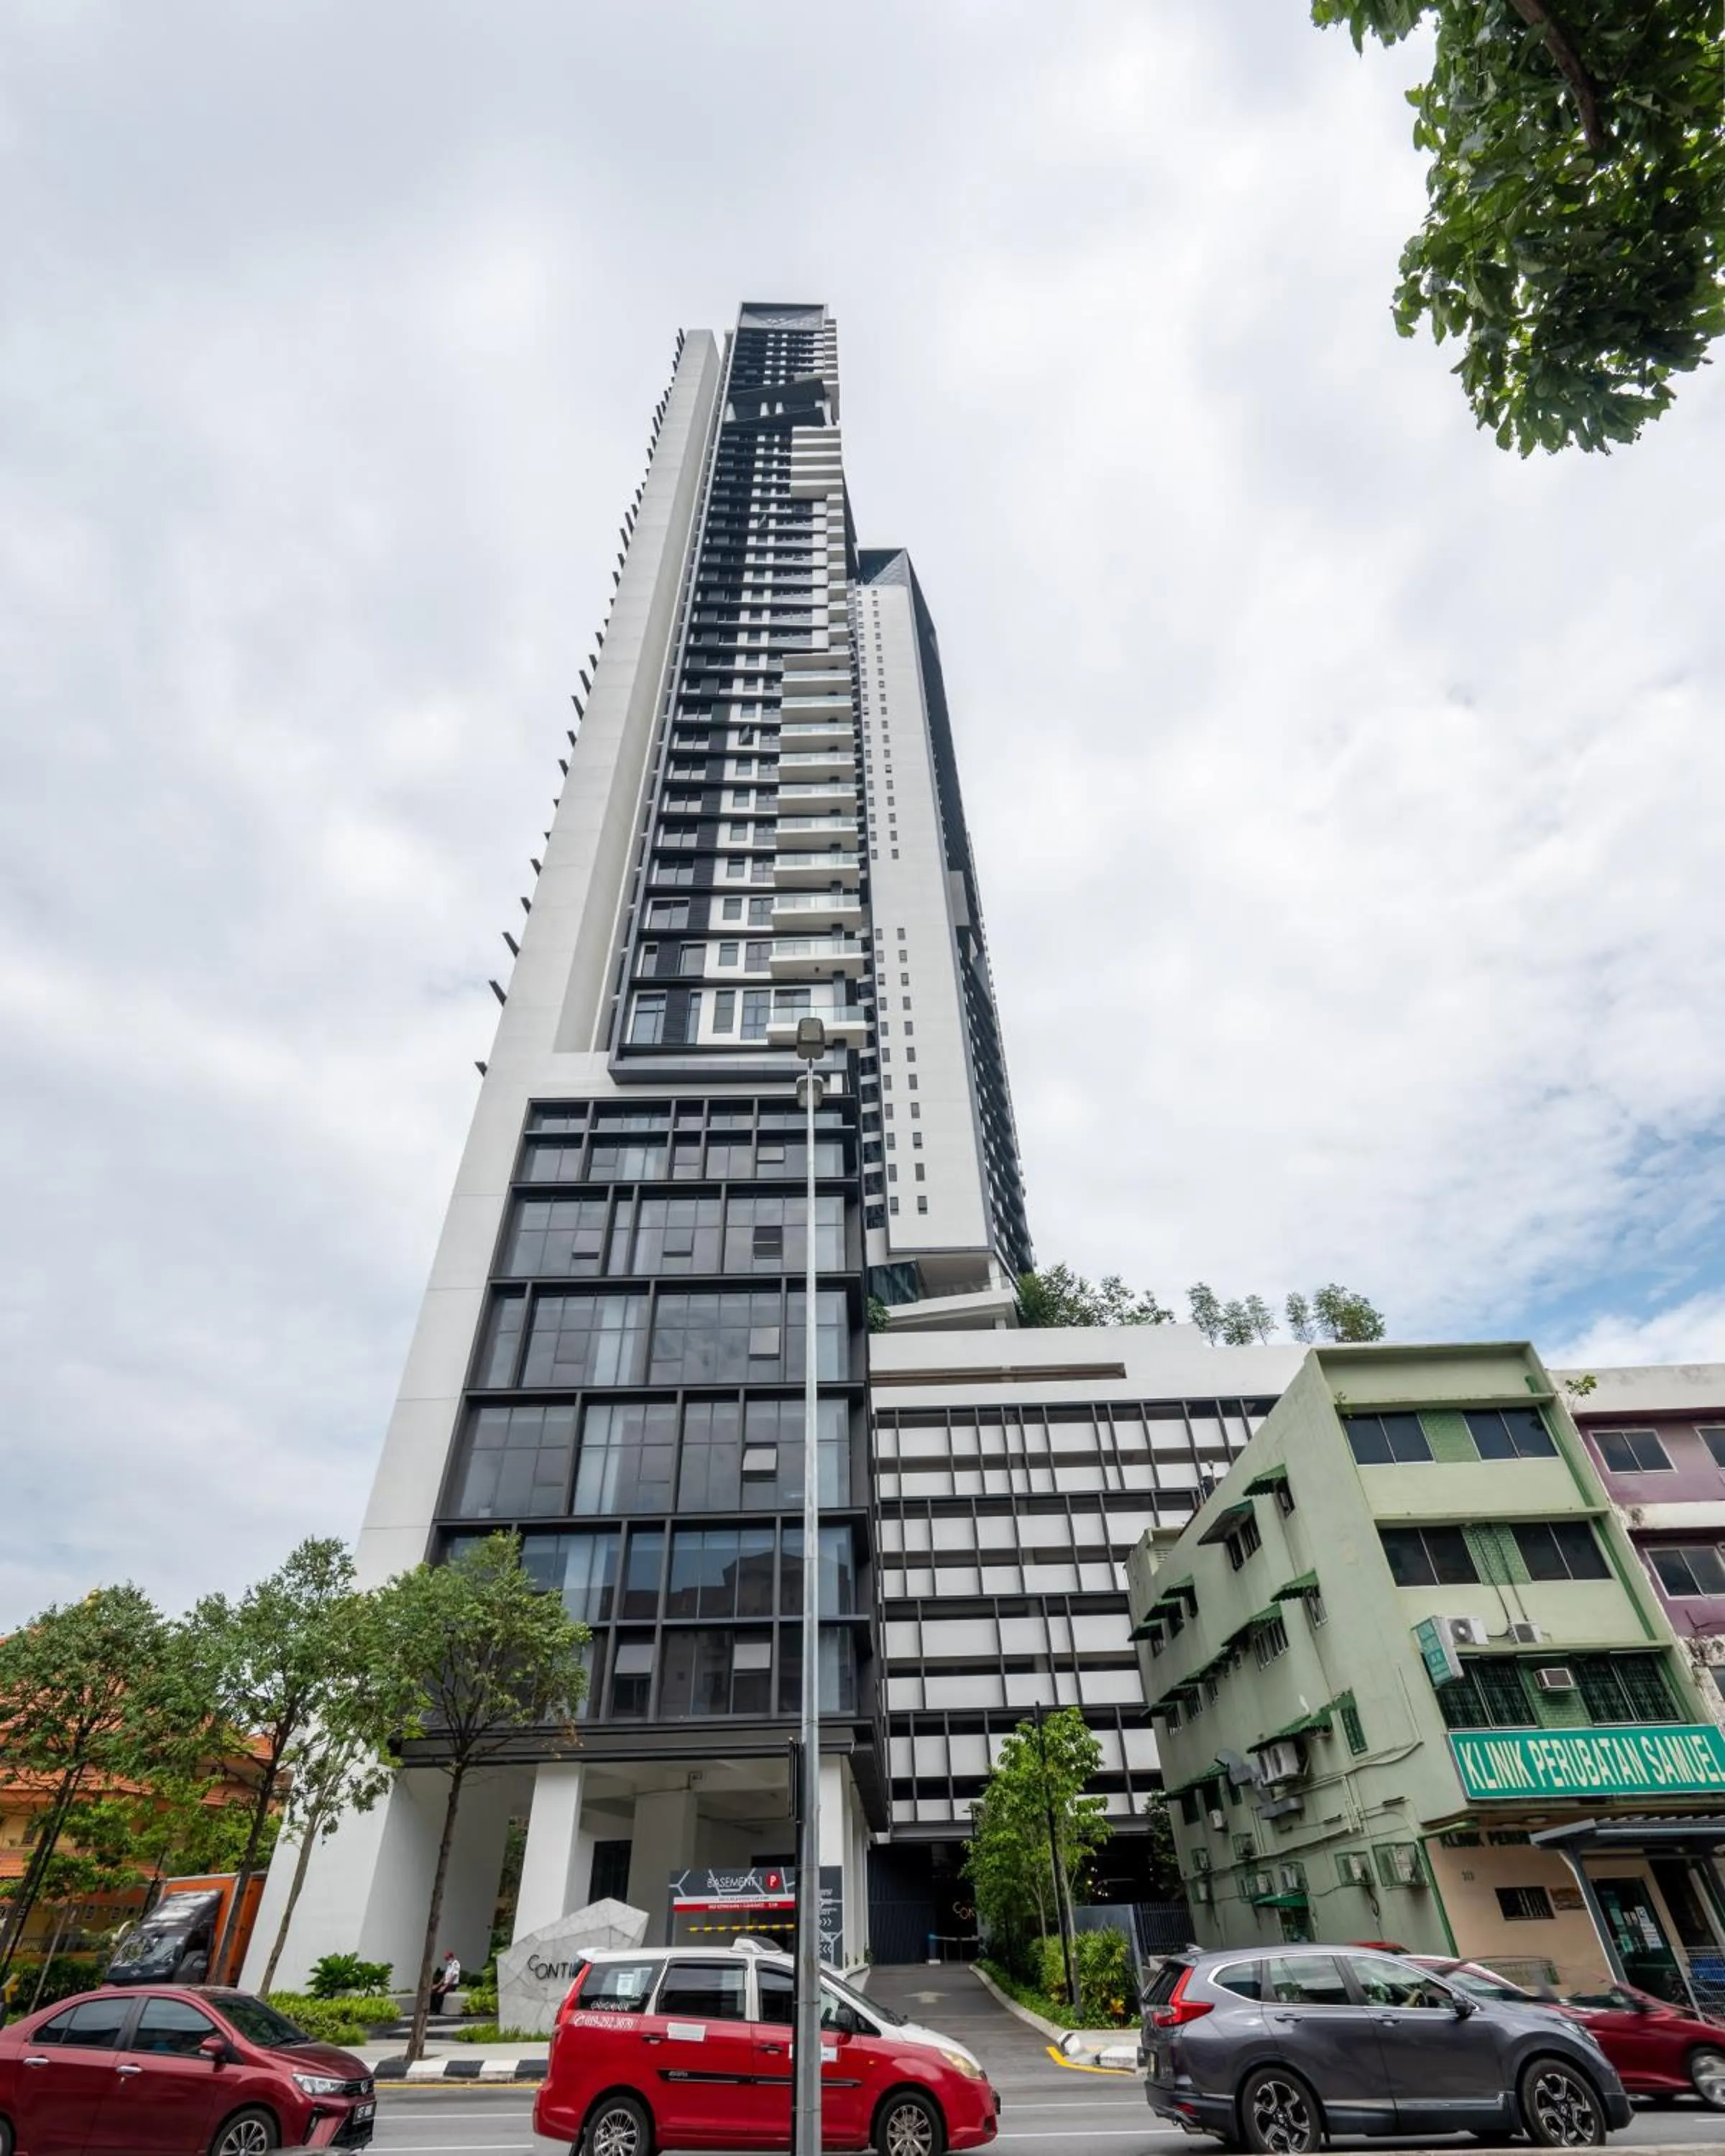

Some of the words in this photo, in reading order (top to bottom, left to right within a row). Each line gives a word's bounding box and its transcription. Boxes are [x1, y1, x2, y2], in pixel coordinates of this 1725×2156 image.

[1459, 1741, 1536, 1789] KLINIK
[1527, 1737, 1651, 1787] PERUBATAN
[1639, 1733, 1725, 1784] SAMUEL
[707, 1876, 756, 1888] BASEMENT
[770, 1874, 777, 1886] P
